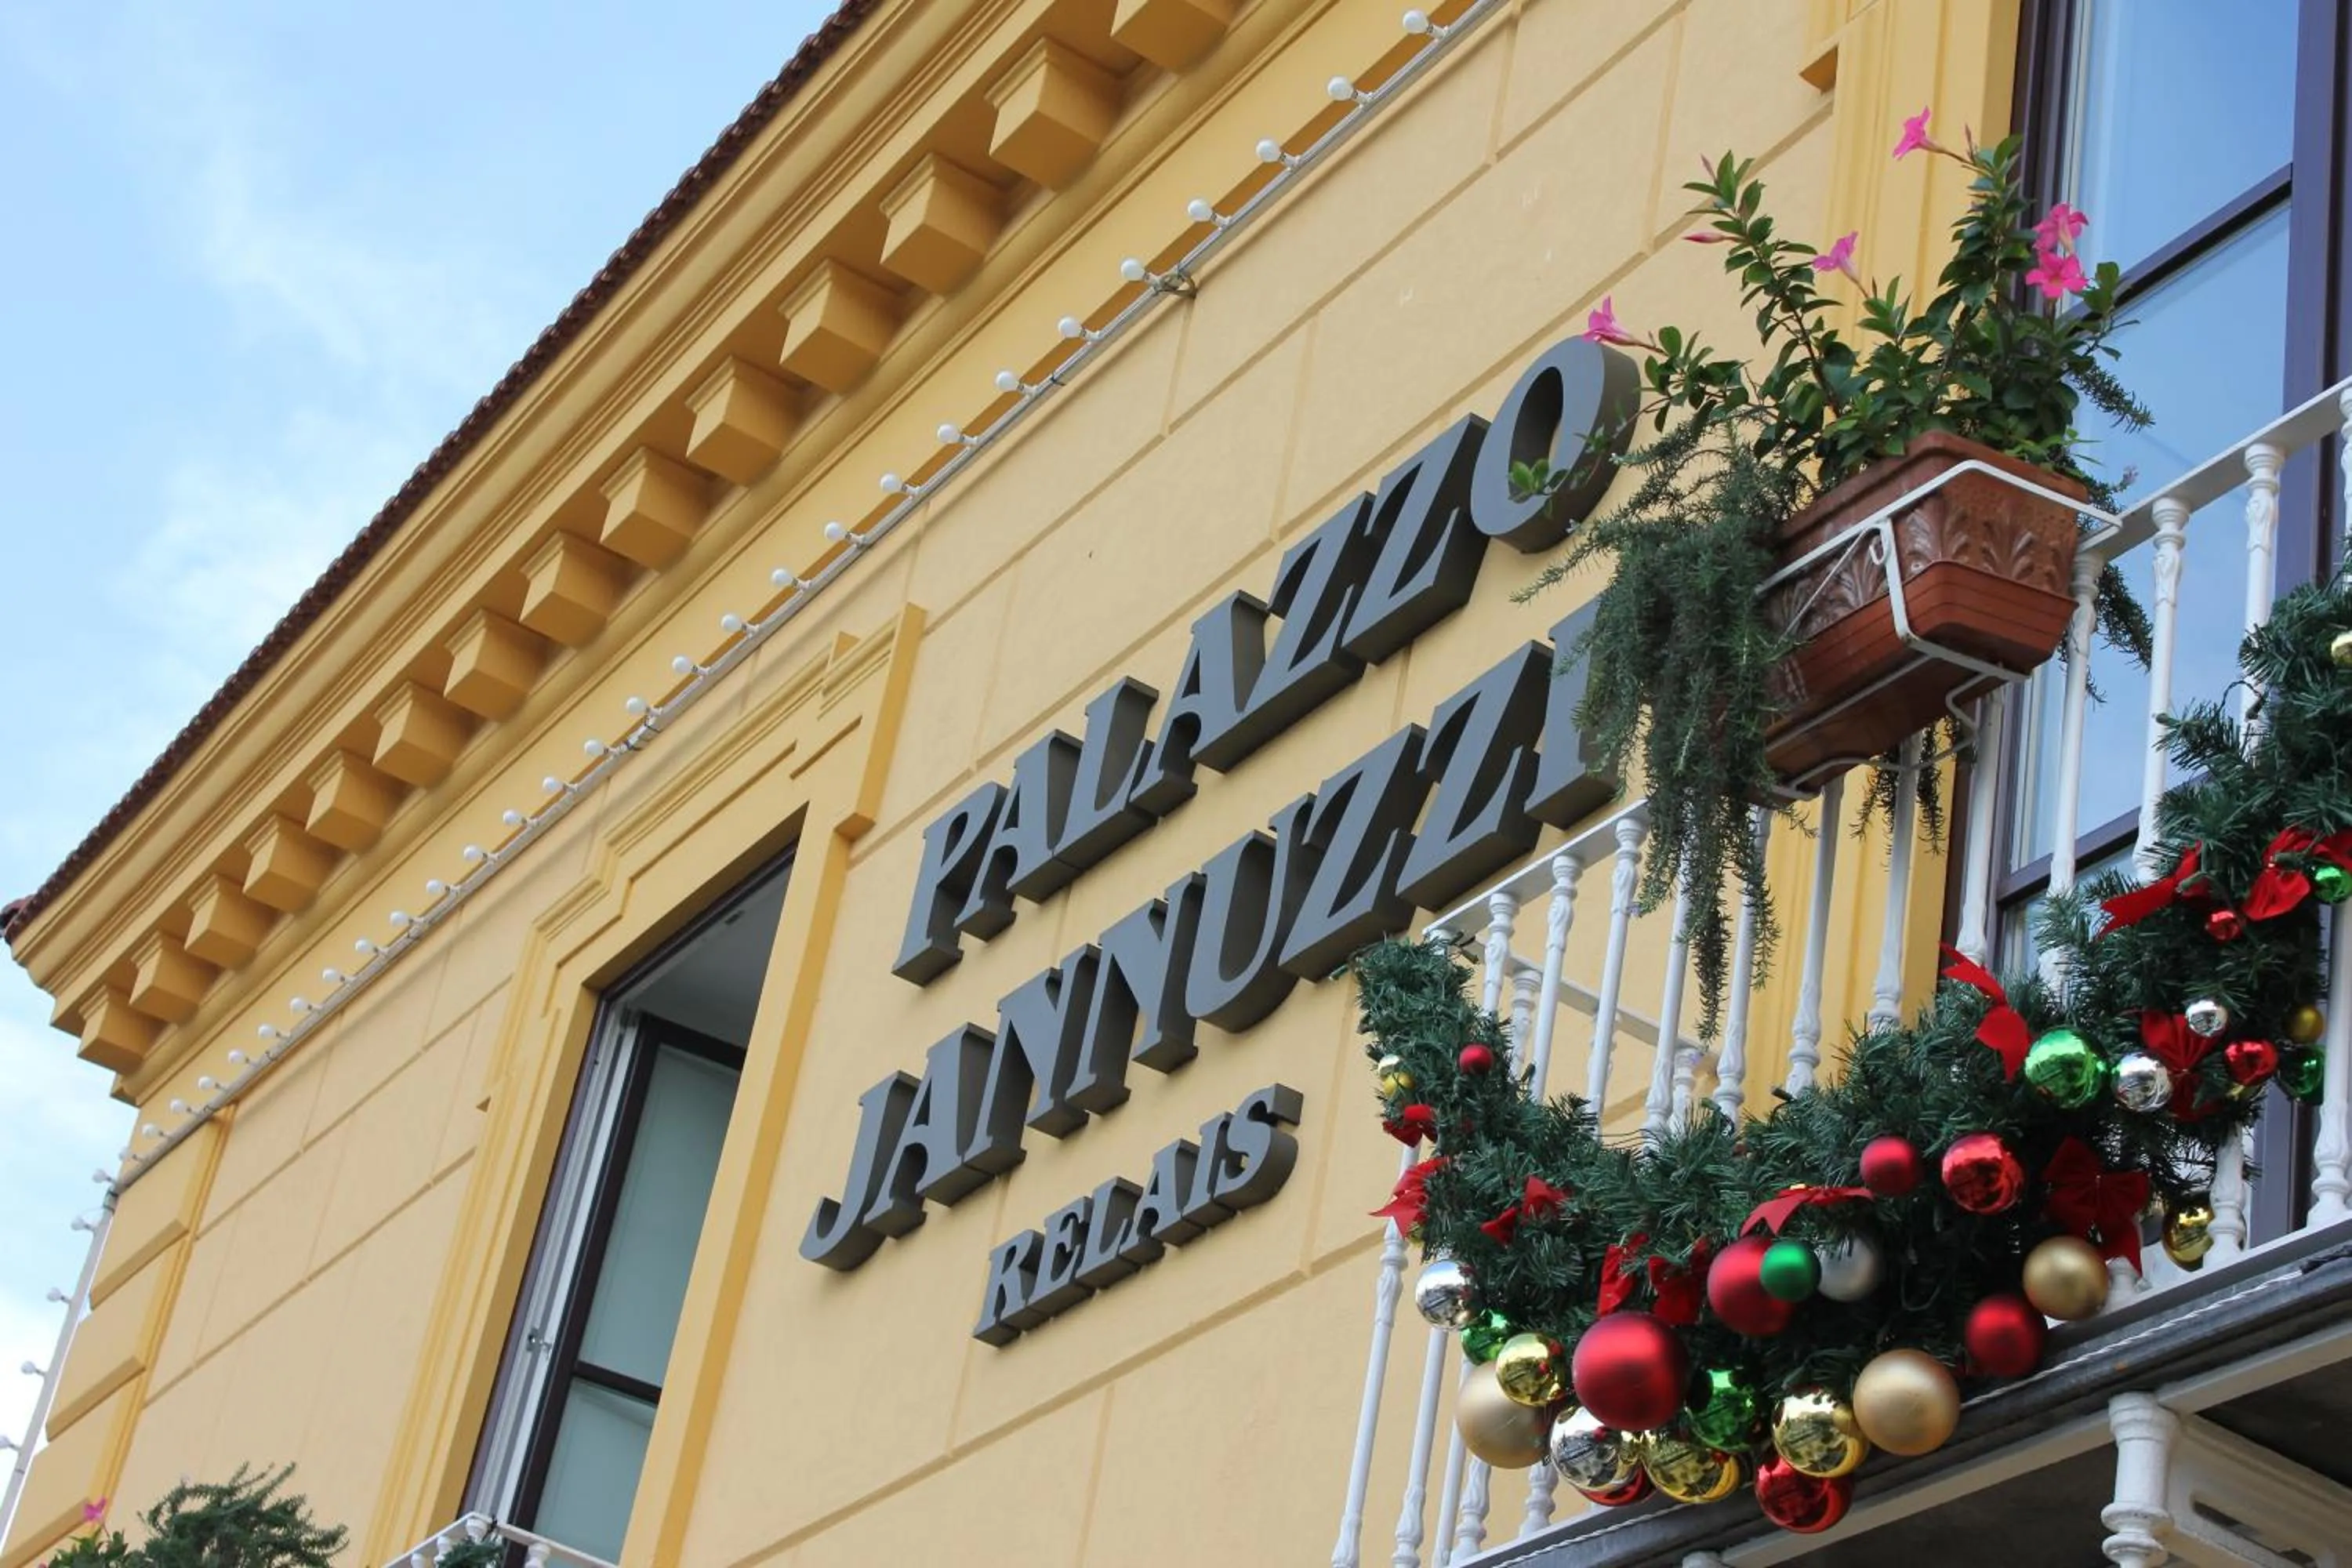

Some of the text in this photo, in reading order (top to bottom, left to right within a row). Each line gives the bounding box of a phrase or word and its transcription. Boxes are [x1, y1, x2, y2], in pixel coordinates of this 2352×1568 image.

[799, 594, 1615, 1269] JANNUZZI
[894, 335, 1635, 980] PALAZZO
[973, 1083, 1303, 1345] RELAIS
